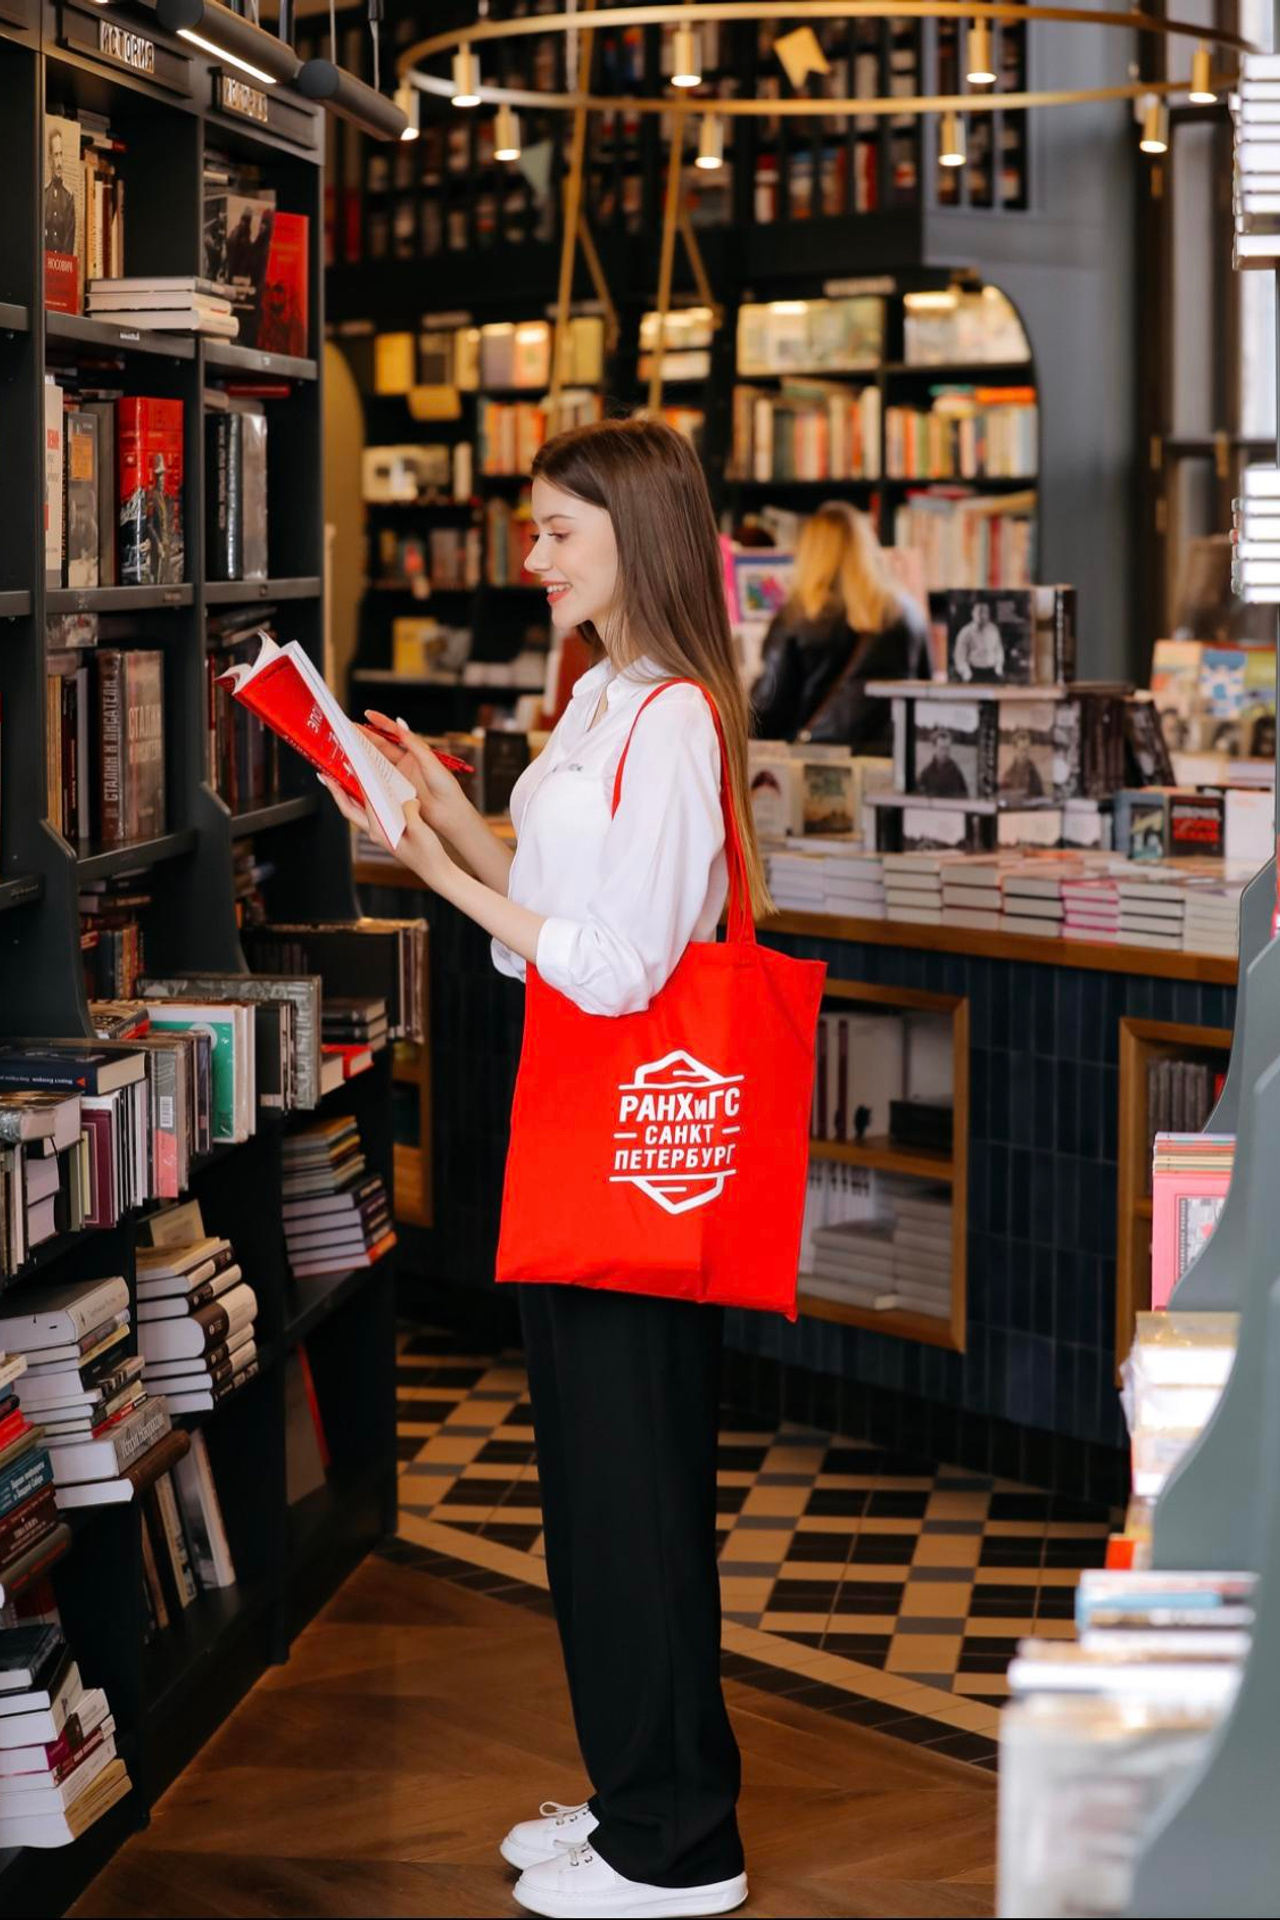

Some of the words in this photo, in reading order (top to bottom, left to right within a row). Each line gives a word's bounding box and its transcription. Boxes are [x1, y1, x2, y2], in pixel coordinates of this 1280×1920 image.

[100, 18, 155, 74] ИСТОРИЯ
[103, 679, 118, 741] ПИСАТЕЛИ
[103, 744, 118, 753] И
[103, 756, 118, 802] СТАЛИН
[619, 1087, 740, 1122] РАНХиГС
[644, 1124, 715, 1146] САНКТ
[613, 1143, 737, 1171] ПЕТЕРБУРГ
